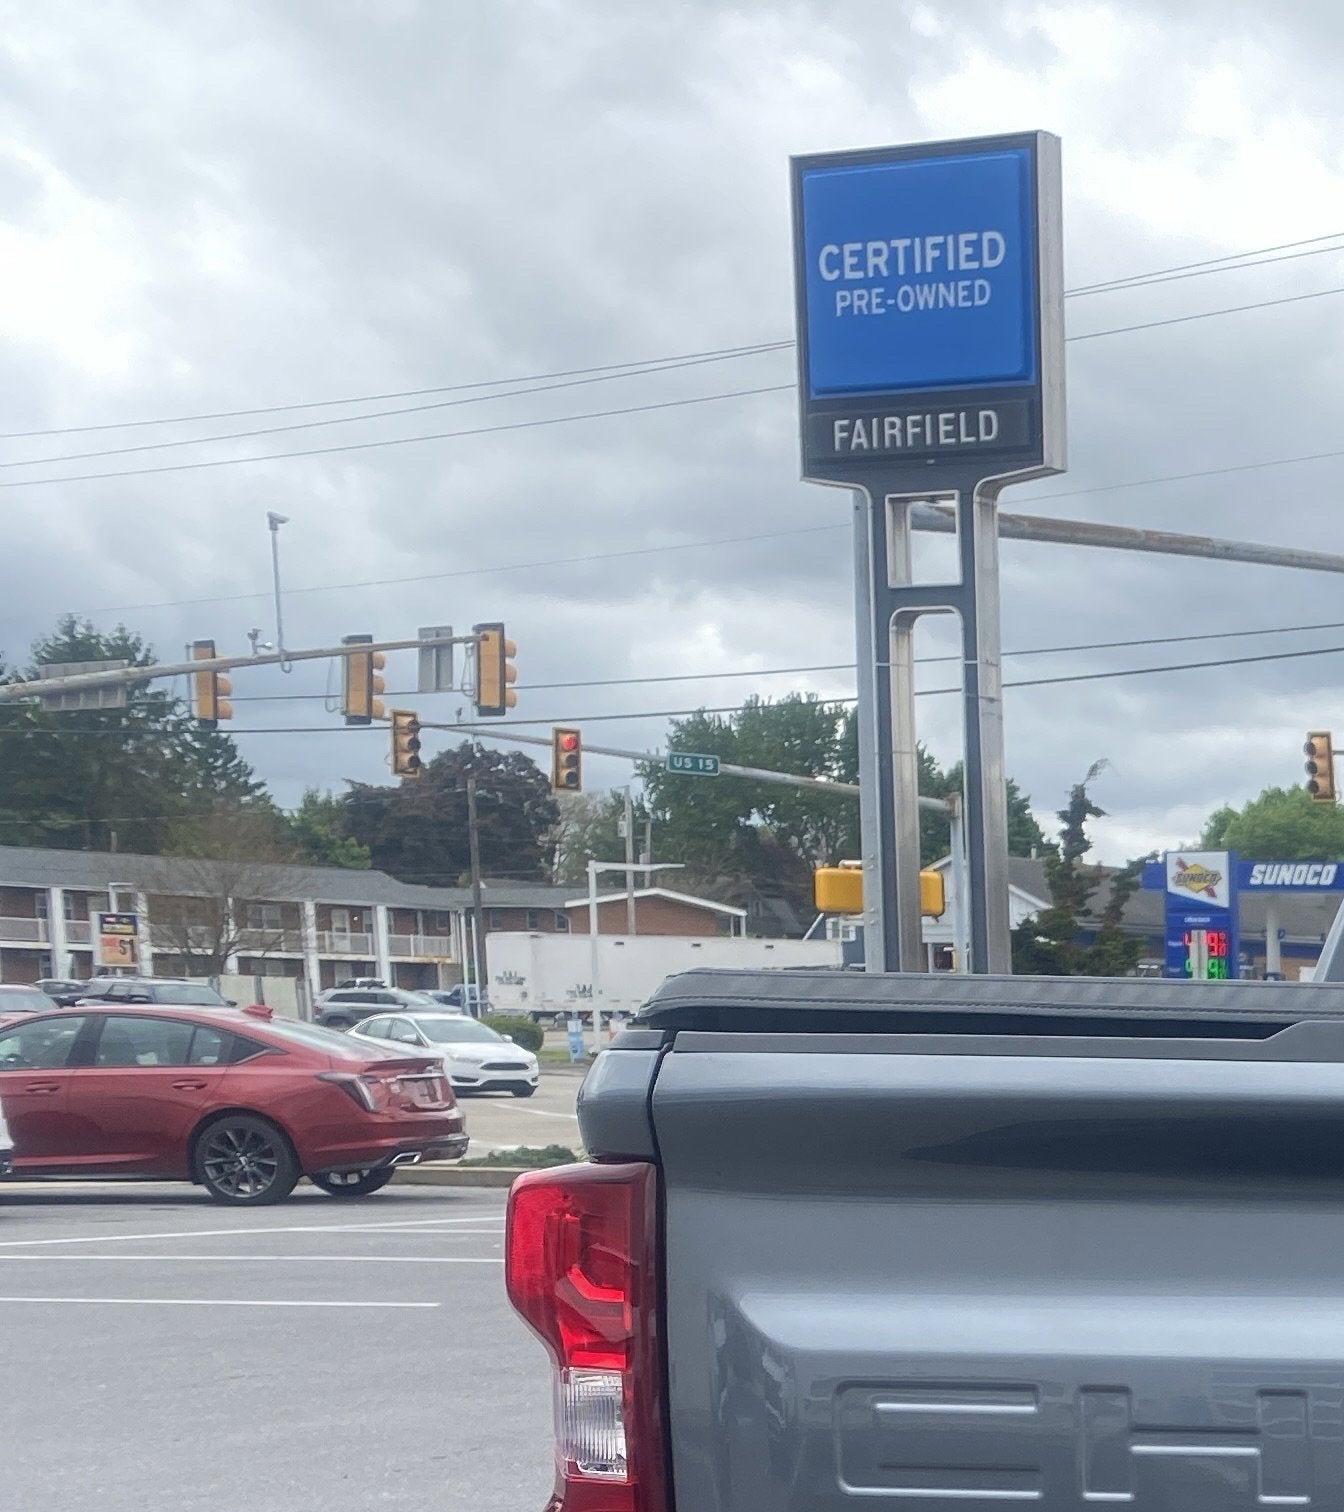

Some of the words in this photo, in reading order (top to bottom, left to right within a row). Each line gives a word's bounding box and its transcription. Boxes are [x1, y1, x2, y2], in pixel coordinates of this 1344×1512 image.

[818, 231, 1006, 281] CERTIFIED
[835, 279, 992, 317] PRE-OWNED
[833, 410, 999, 451] FAIRFIELD
[673, 757, 693, 768] US
[699, 759, 714, 770] 15
[1174, 871, 1219, 885] SUNOCO
[1250, 864, 1338, 886] SUNOCO
